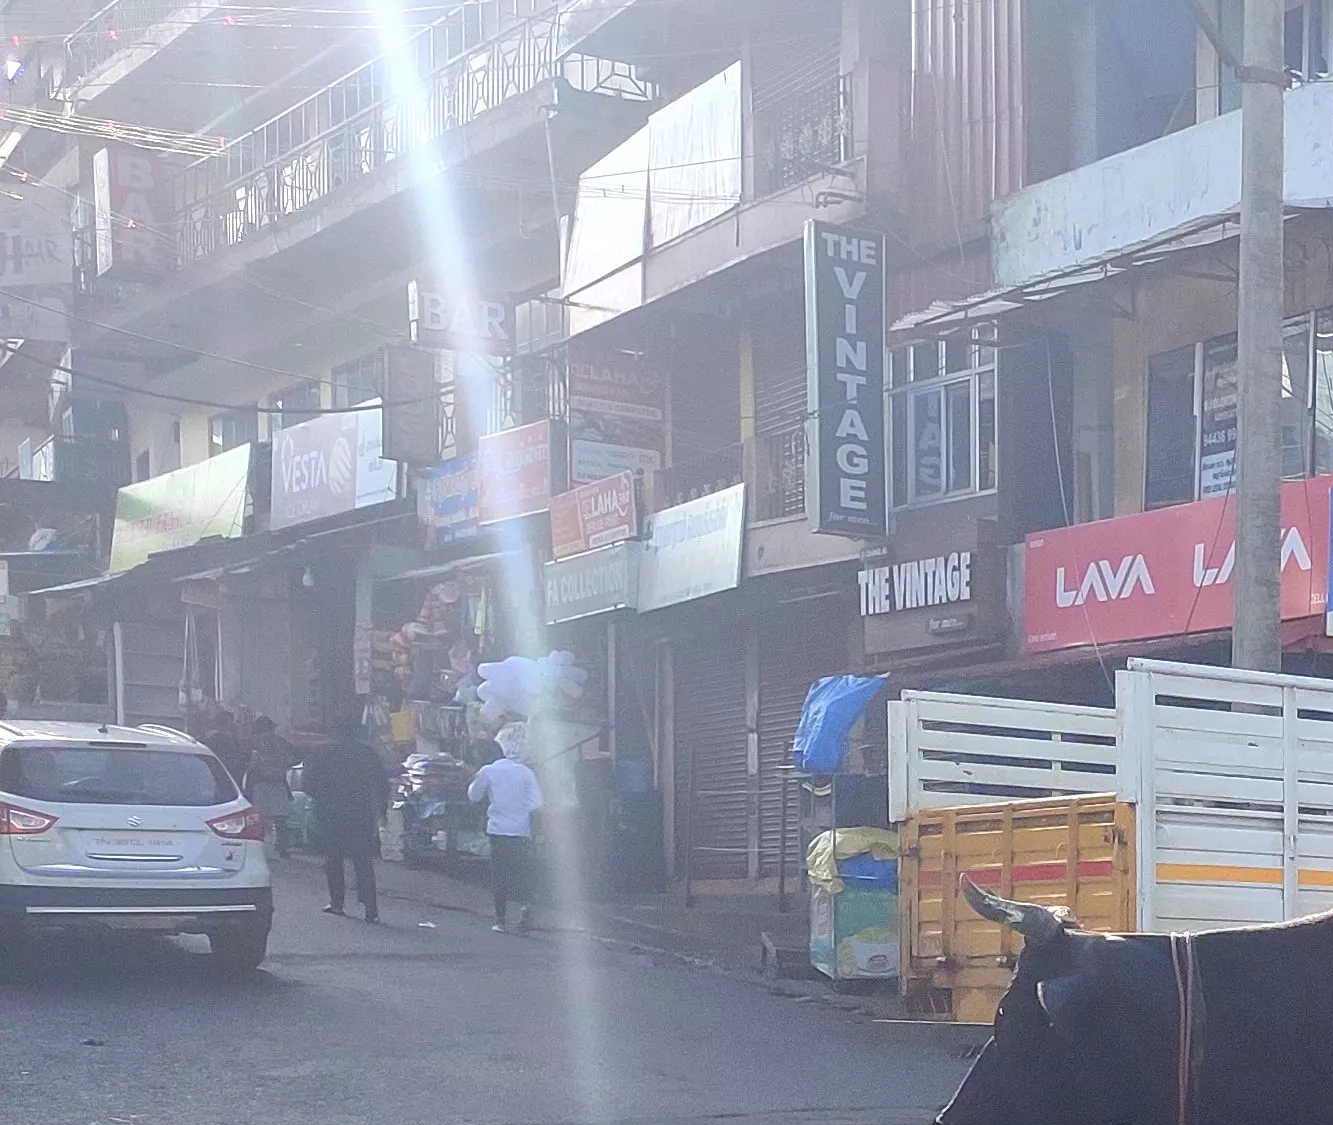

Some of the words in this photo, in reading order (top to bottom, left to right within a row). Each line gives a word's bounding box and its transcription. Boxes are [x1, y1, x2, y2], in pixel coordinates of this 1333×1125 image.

[822, 232, 877, 266] THE
[421, 293, 509, 340] BAR
[834, 267, 870, 511] VINTAGE
[281, 434, 327, 494] VESTA
[857, 566, 890, 616] THE
[892, 551, 971, 611] VINTAGE
[1056, 554, 1155, 608] LAVA
[1193, 527, 1312, 588] LAA
